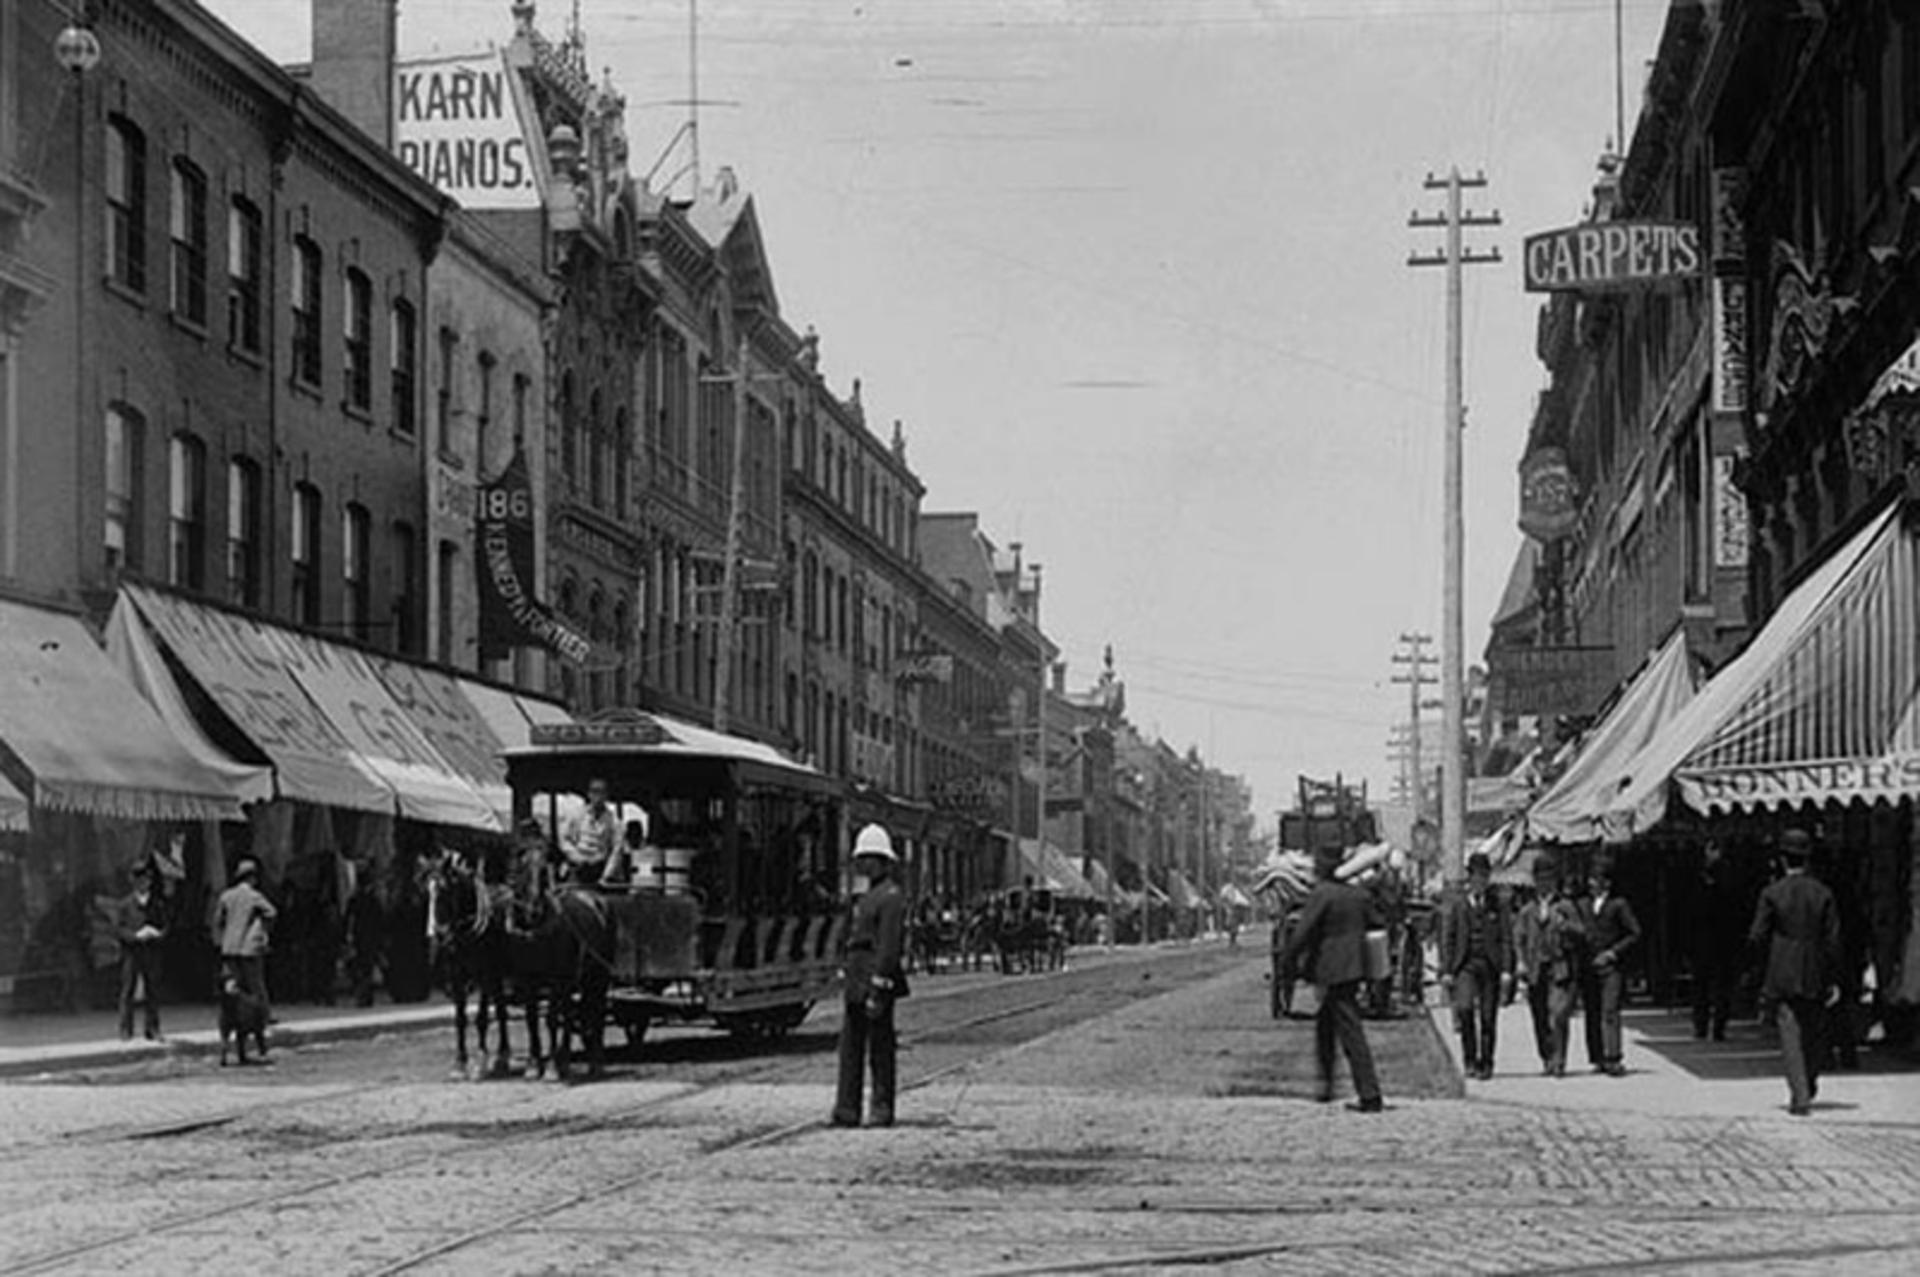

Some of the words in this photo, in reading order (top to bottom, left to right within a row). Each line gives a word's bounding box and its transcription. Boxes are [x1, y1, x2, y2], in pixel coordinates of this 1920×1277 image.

[399, 72, 502, 121] KARN
[400, 138, 532, 189] PIANOS.
[1529, 225, 1698, 285] CARPETS
[479, 489, 528, 519] 186
